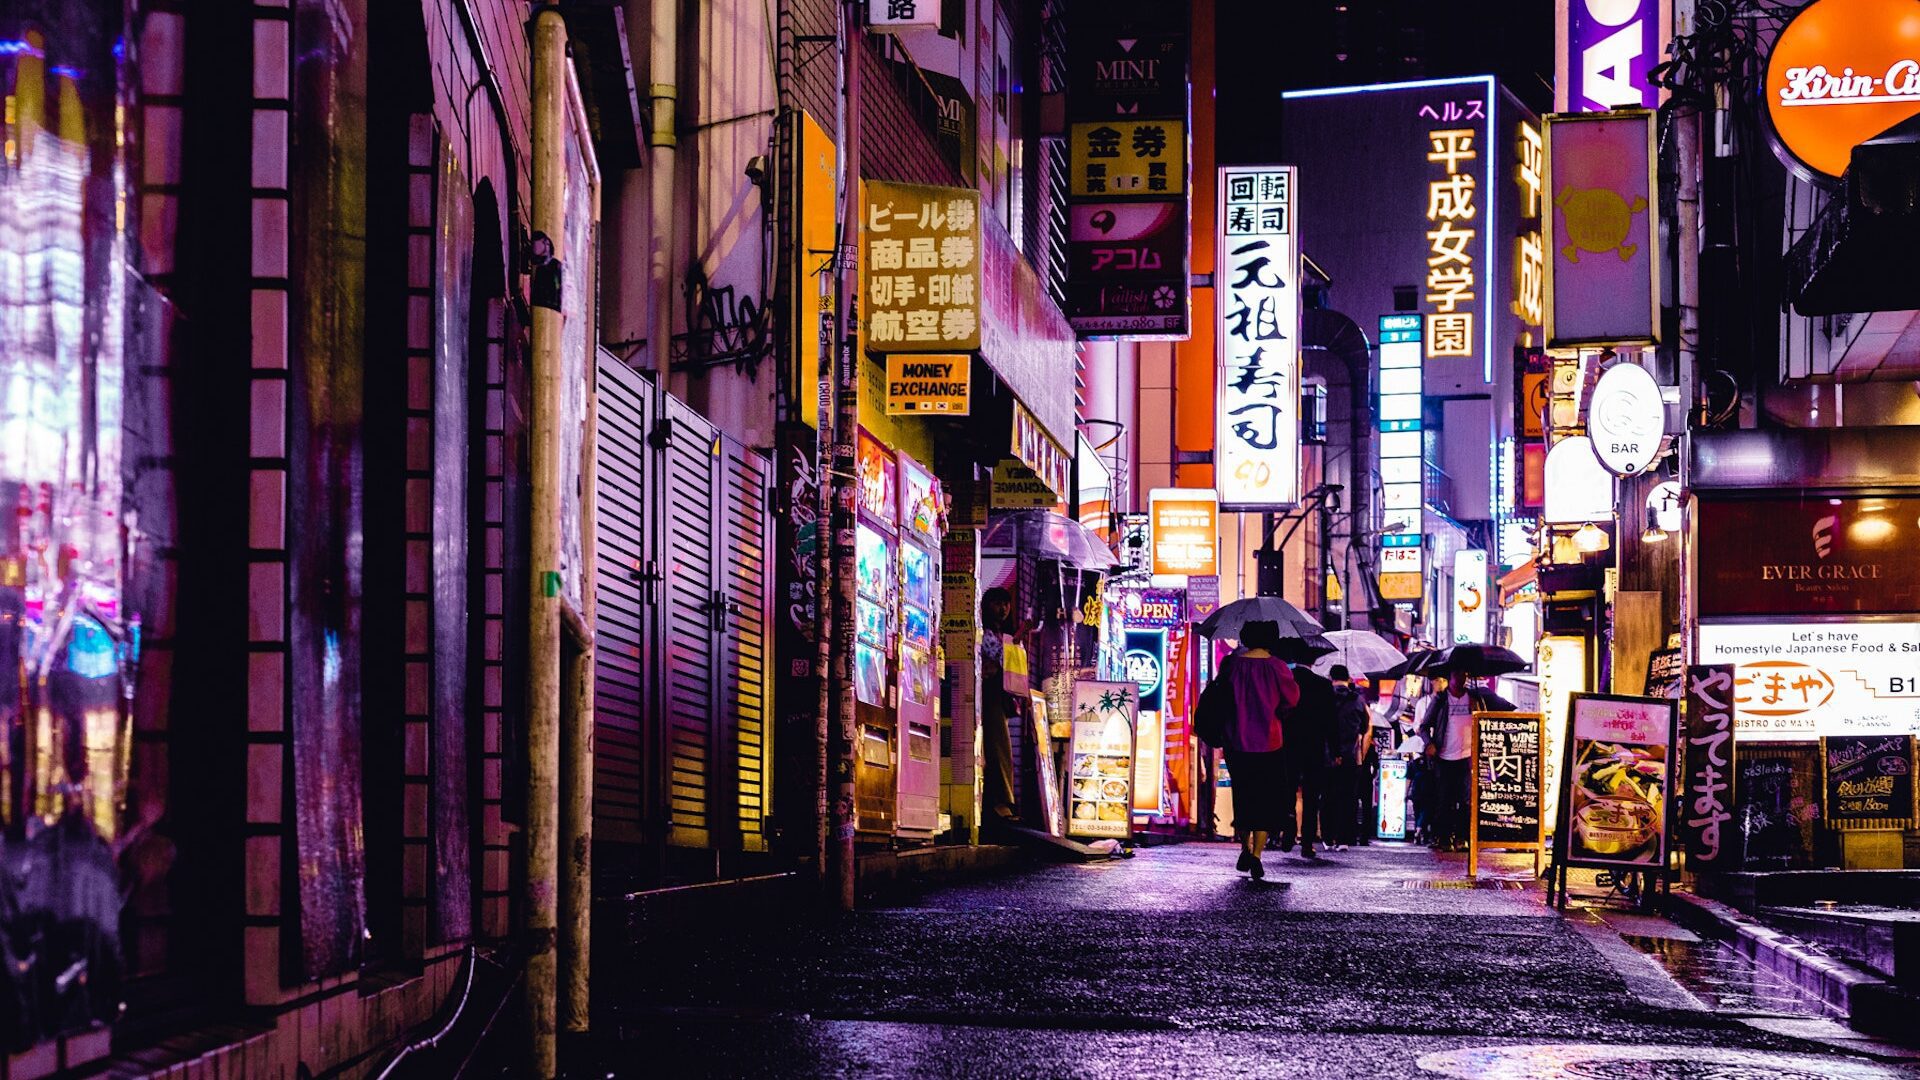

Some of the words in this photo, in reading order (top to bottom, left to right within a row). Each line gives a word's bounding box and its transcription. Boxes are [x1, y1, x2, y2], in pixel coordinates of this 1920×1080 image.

[1096, 60, 1161, 80] MINT
[1419, 100, 1486, 121] ヘルス
[1088, 126, 1167, 158] 金券
[1230, 176, 1285, 201] 回転
[869, 199, 976, 232] ビール券
[1230, 206, 1285, 234] 寿司
[870, 236, 975, 271] 商品券
[1426, 129, 1477, 359] 平成女学園
[1090, 247, 1162, 272] アコム
[870, 309, 976, 342] 航空券
[1225, 240, 1287, 450] 元祖寿司
[902, 363, 953, 379] MONEY
[890, 381, 967, 397] EXCHANGE
[1611, 443, 1639, 453] BAR
[1762, 565, 1812, 580] EVER
[1818, 565, 1882, 580] GRACE
[1131, 603, 1174, 618] OPEN
[1828, 632, 1859, 641] have
[1715, 644, 1782, 655] Homestyle
[1786, 644, 1847, 655] Japanese
[1851, 643, 1883, 653] Food
[1888, 643, 1896, 652] &
[1126, 657, 1152, 670] TAX
[1734, 671, 1824, 704] ごまや
[1509, 732, 1538, 743] WINE
[1489, 746, 1522, 782] 肉
[1688, 668, 1732, 861] やってます
[1490, 782, 1522, 792] ビストロ
[1589, 801, 1650, 825] ごまや
